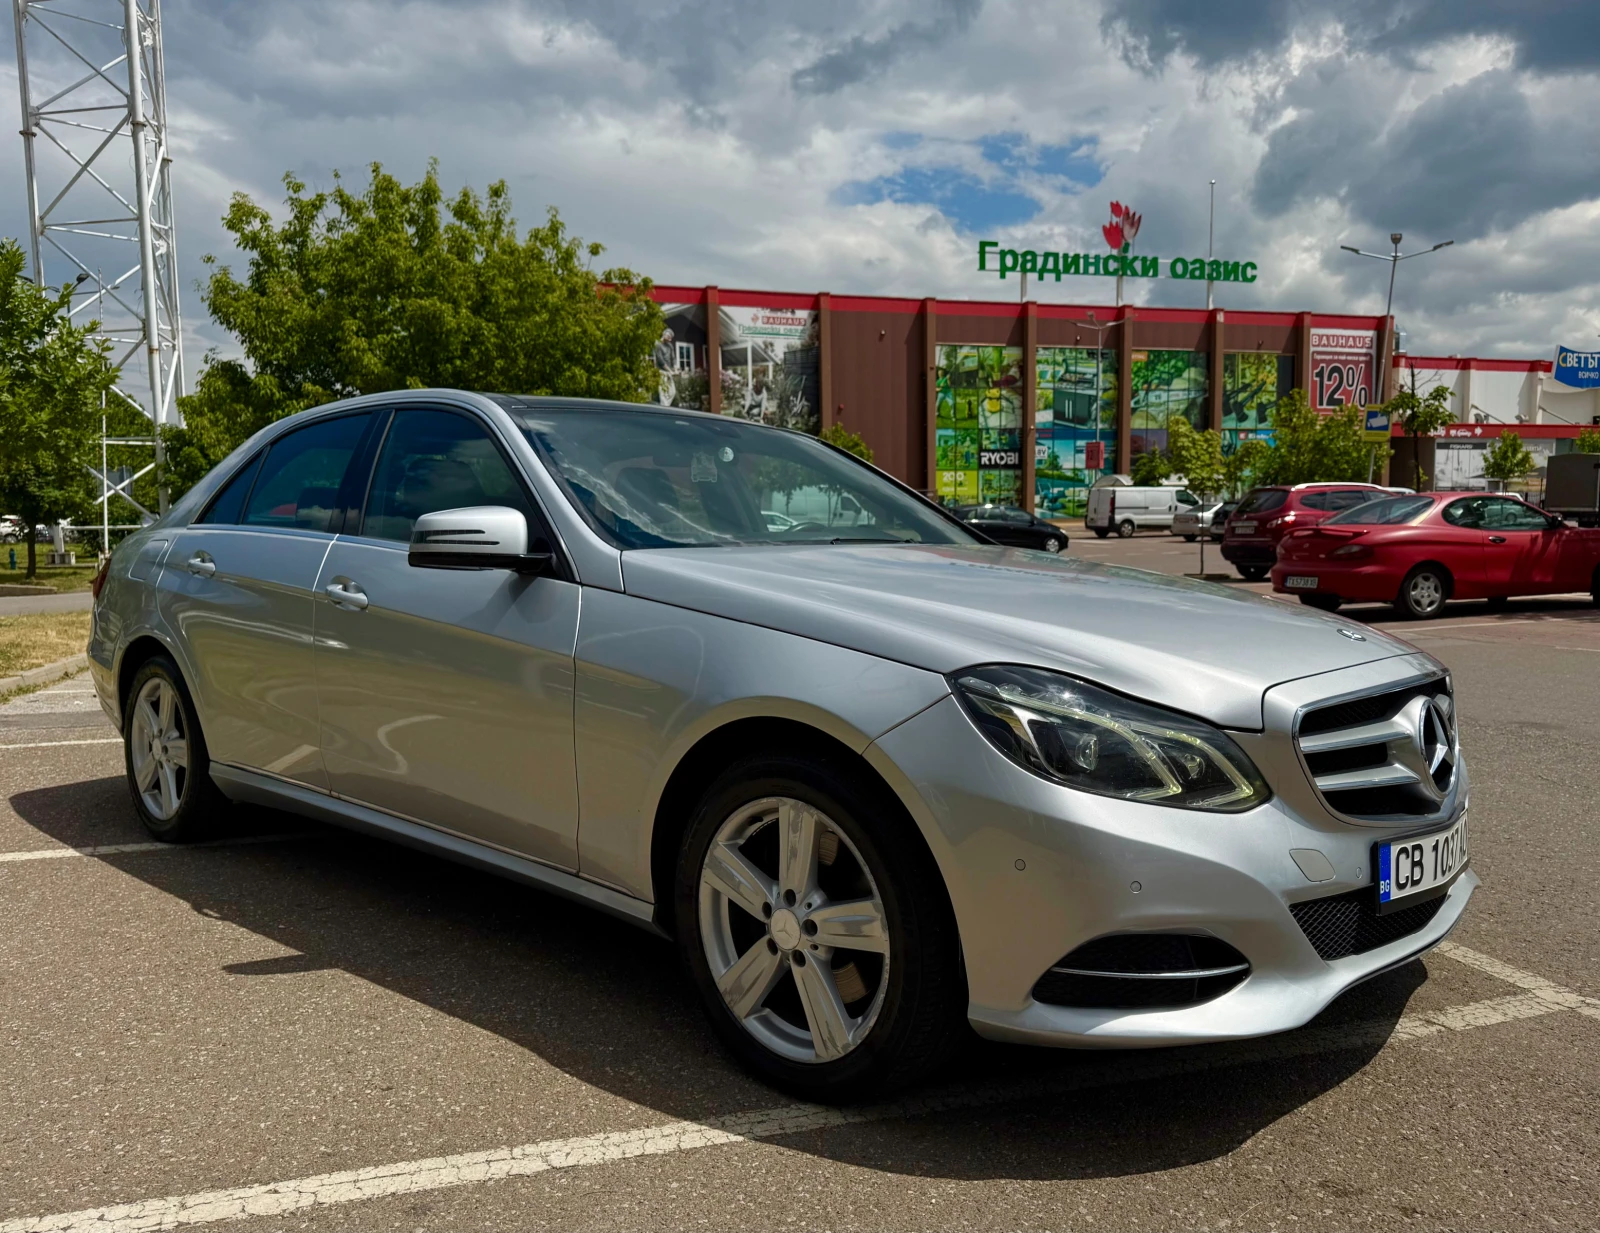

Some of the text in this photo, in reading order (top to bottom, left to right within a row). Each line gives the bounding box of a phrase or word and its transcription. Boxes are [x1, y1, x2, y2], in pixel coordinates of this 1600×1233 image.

[978, 240, 1258, 283] Градински оазис
[762, 316, 806, 326] BAUHAUS
[1312, 335, 1372, 347] BAUHAUS
[1559, 352, 1600, 369] СВЕТЪТ
[1313, 363, 1369, 410] 12%
[980, 452, 1019, 465] RYOBI
[1395, 843, 1424, 891] CB
[1380, 879, 1390, 894] BG
